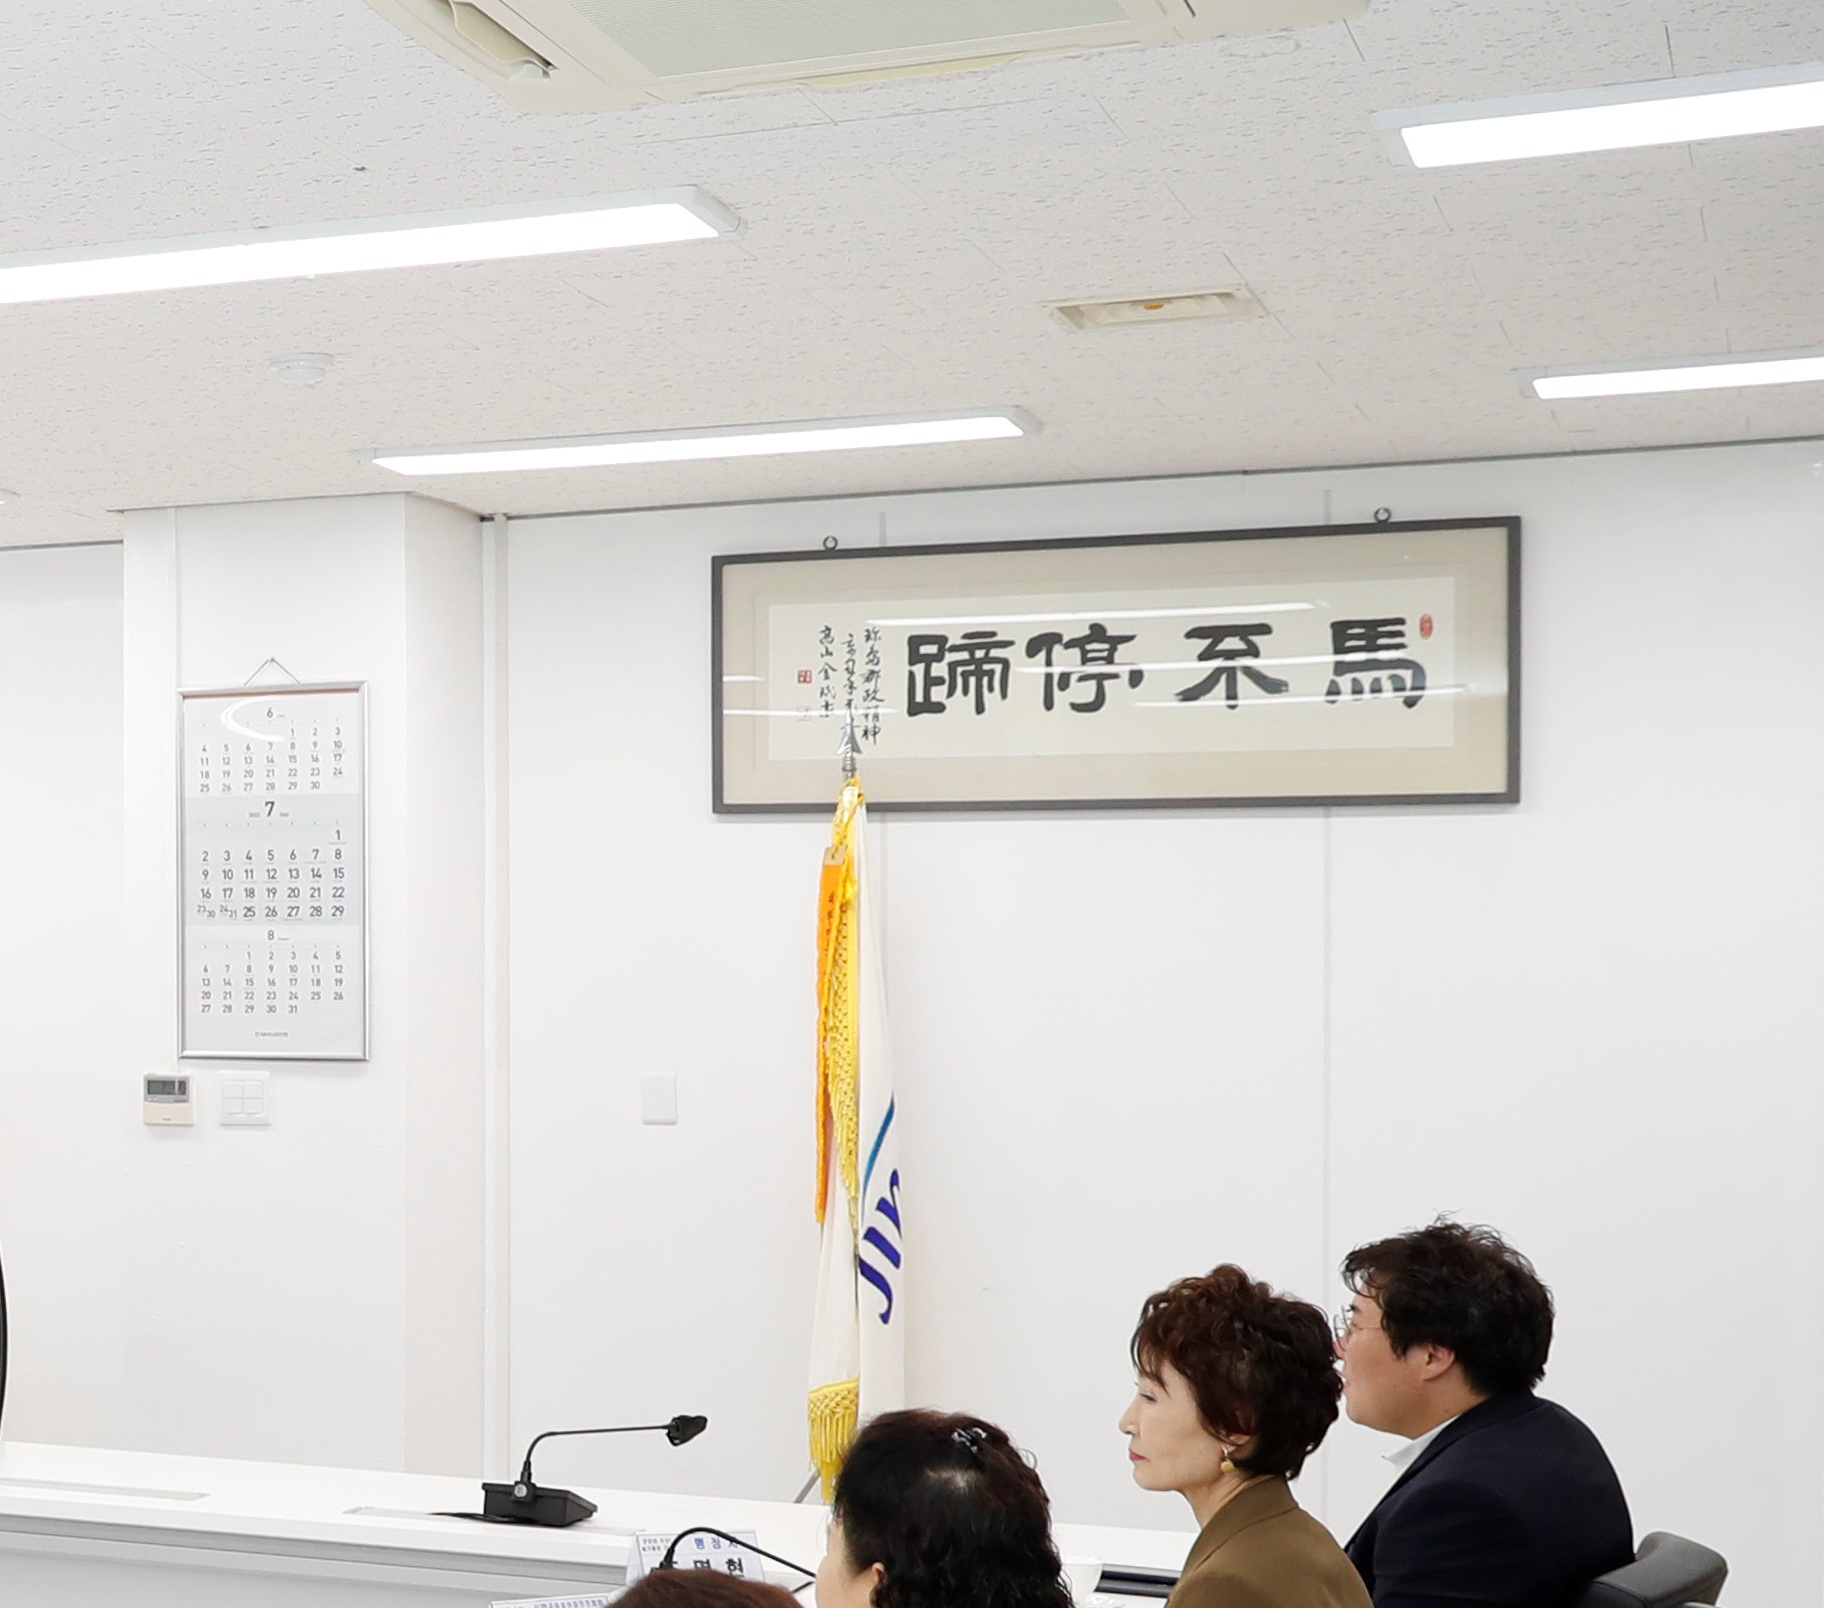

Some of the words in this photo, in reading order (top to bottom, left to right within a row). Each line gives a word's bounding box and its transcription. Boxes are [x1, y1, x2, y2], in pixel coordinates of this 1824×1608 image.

[266, 707, 274, 718] 6
[312, 728, 318, 736] 2
[335, 727, 341, 735] 3
[223, 744, 230, 752] 5
[245, 743, 252, 751] 6
[267, 742, 274, 750] 7
[289, 742, 296, 750] 8
[312, 741, 319, 749] 9
[333, 740, 344, 749] 10
[199, 757, 210, 765] 11
[221, 757, 231, 765] 12
[243, 756, 253, 764] 13
[265, 756, 276, 764] 14
[287, 755, 298, 763] 15
[310, 754, 321, 763] 16
[333, 753, 343, 762] 17
[200, 771, 210, 779] 18
[222, 770, 232, 778] 19
[242, 769, 254, 778] 20
[265, 769, 276, 778] 21
[287, 768, 298, 777] 22
[309, 767, 321, 776] 23
[332, 767, 344, 776] 24
[199, 784, 211, 792] 25
[221, 783, 232, 792] 26
[243, 783, 254, 791] 27
[265, 782, 276, 791] 28
[287, 782, 299, 790] 29
[310, 781, 321, 789] 30
[264, 801, 276, 817] 7
[334, 829, 341, 841] 1
[201, 850, 210, 862] 2
[223, 850, 231, 862] 3
[244, 850, 253, 861] 4
[267, 849, 275, 861] 5
[289, 849, 298, 860] 6
[311, 848, 320, 860] 7
[333, 848, 343, 860] 8
[201, 869, 210, 880] 9
[221, 869, 234, 880] 10
[243, 868, 255, 880] 11
[265, 868, 278, 880] 12
[287, 868, 301, 880] 13
[309, 867, 323, 879] 14
[332, 867, 346, 879] 15
[199, 887, 213, 899] 16
[221, 887, 234, 899] 17
[243, 887, 256, 899] 18
[265, 887, 278, 899] 19
[286, 887, 301, 899] 20
[308, 887, 322, 898] 21
[331, 886, 346, 898] 22
[242, 906, 257, 918] 25
[264, 906, 279, 917] 26
[286, 906, 301, 917] 27
[306, 905, 323, 917] 28
[330, 905, 345, 917] 29
[267, 930, 275, 941] 8
[246, 952, 252, 960] 1
[268, 951, 275, 960] 2
[290, 951, 297, 960] 3
[312, 951, 320, 960] 4
[335, 951, 342, 960] 5
[202, 965, 209, 973] 6
[224, 965, 231, 973] 7
[246, 964, 253, 973] 8
[268, 964, 275, 973] 9
[288, 965, 299, 973] 10
[310, 965, 321, 973] 11
[333, 965, 344, 974] 12
[201, 978, 211, 987] 13
[222, 978, 233, 986] 14
[244, 977, 255, 986] 15
[267, 978, 277, 986] 16
[288, 978, 299, 986] 17
[310, 978, 322, 987] 18
[333, 978, 344, 987] 19
[200, 991, 212, 1000] 20
[222, 991, 233, 1000] 21
[244, 991, 255, 1000] 22
[265, 991, 278, 1000] 23
[288, 991, 299, 1000] 24
[310, 991, 322, 1000] 25
[332, 991, 344, 1000] 26
[200, 1004, 212, 1013] 27
[222, 1004, 233, 1013] 28
[244, 1004, 256, 1013] 29
[266, 1005, 278, 1013] 30
[287, 1004, 298, 1013] 31
